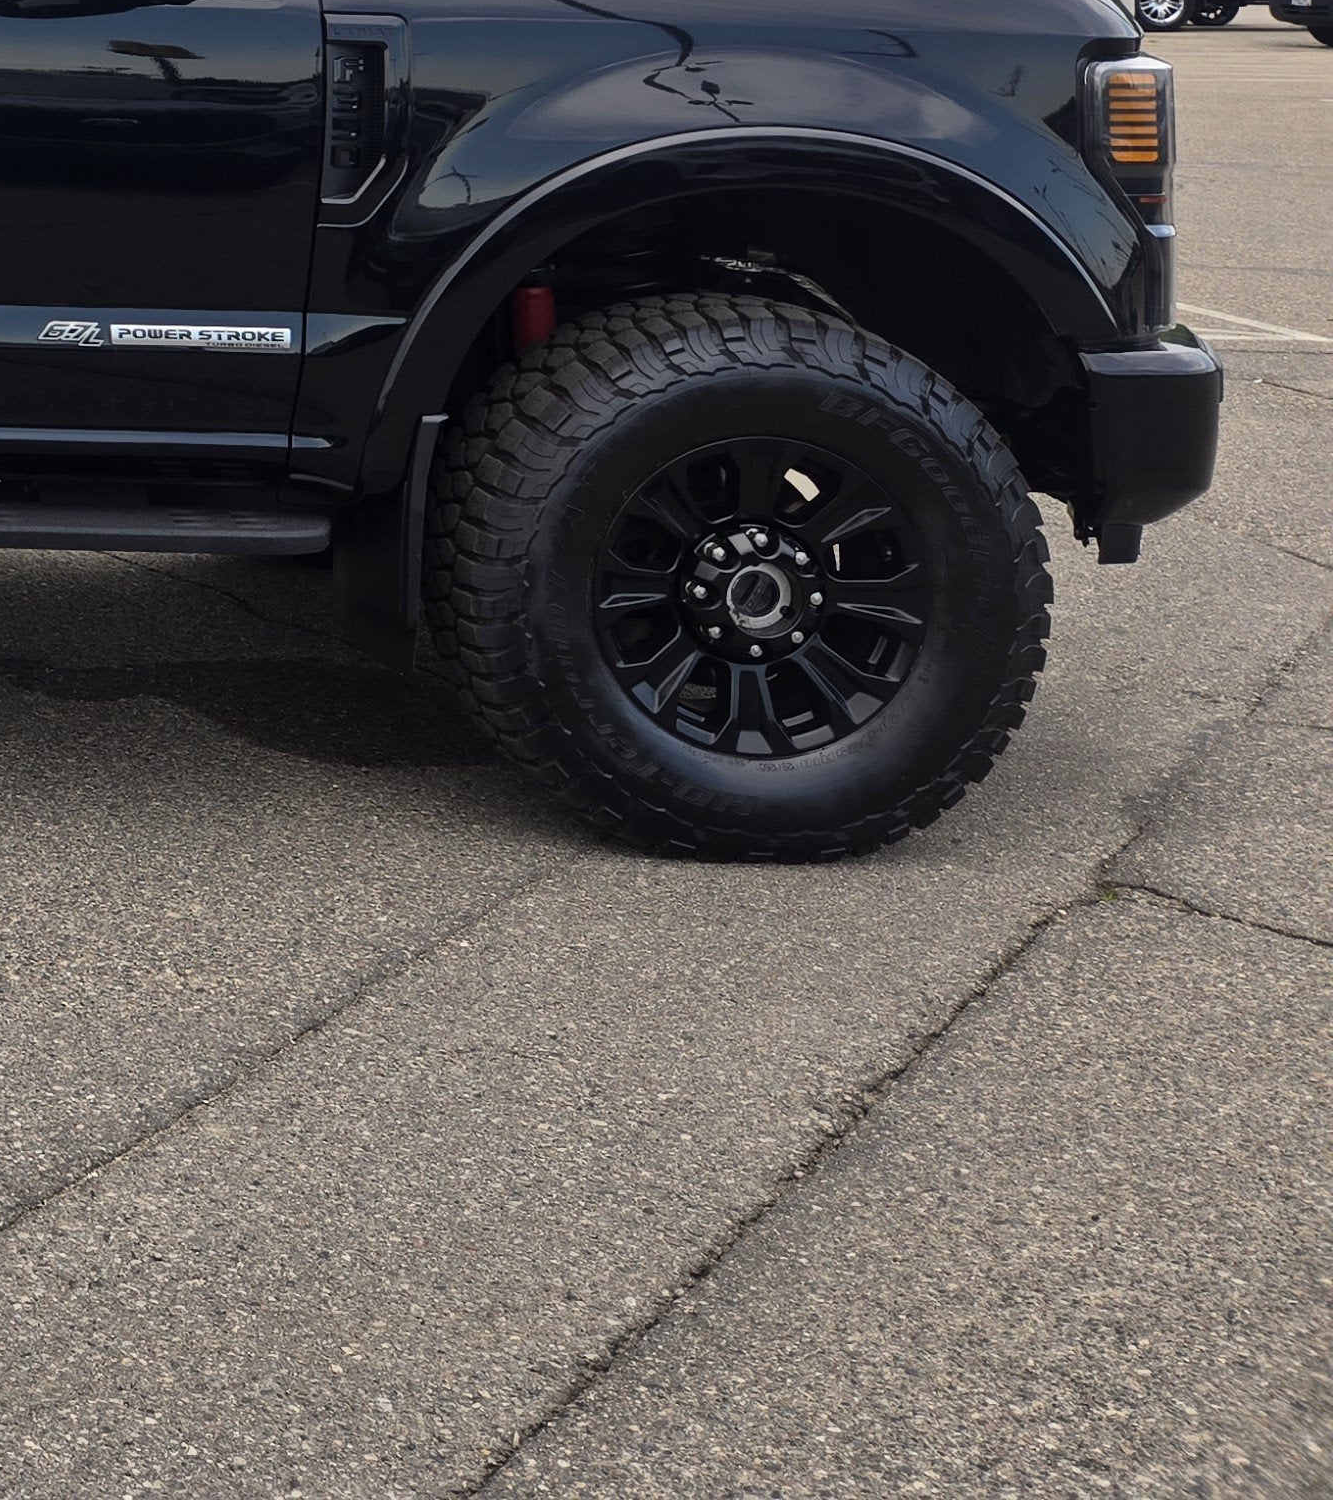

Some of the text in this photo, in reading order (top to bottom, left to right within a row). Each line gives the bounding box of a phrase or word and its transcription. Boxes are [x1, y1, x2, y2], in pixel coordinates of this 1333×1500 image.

[38, 320, 105, 347] 6.7L
[117, 328, 285, 343] POWER STROKE
